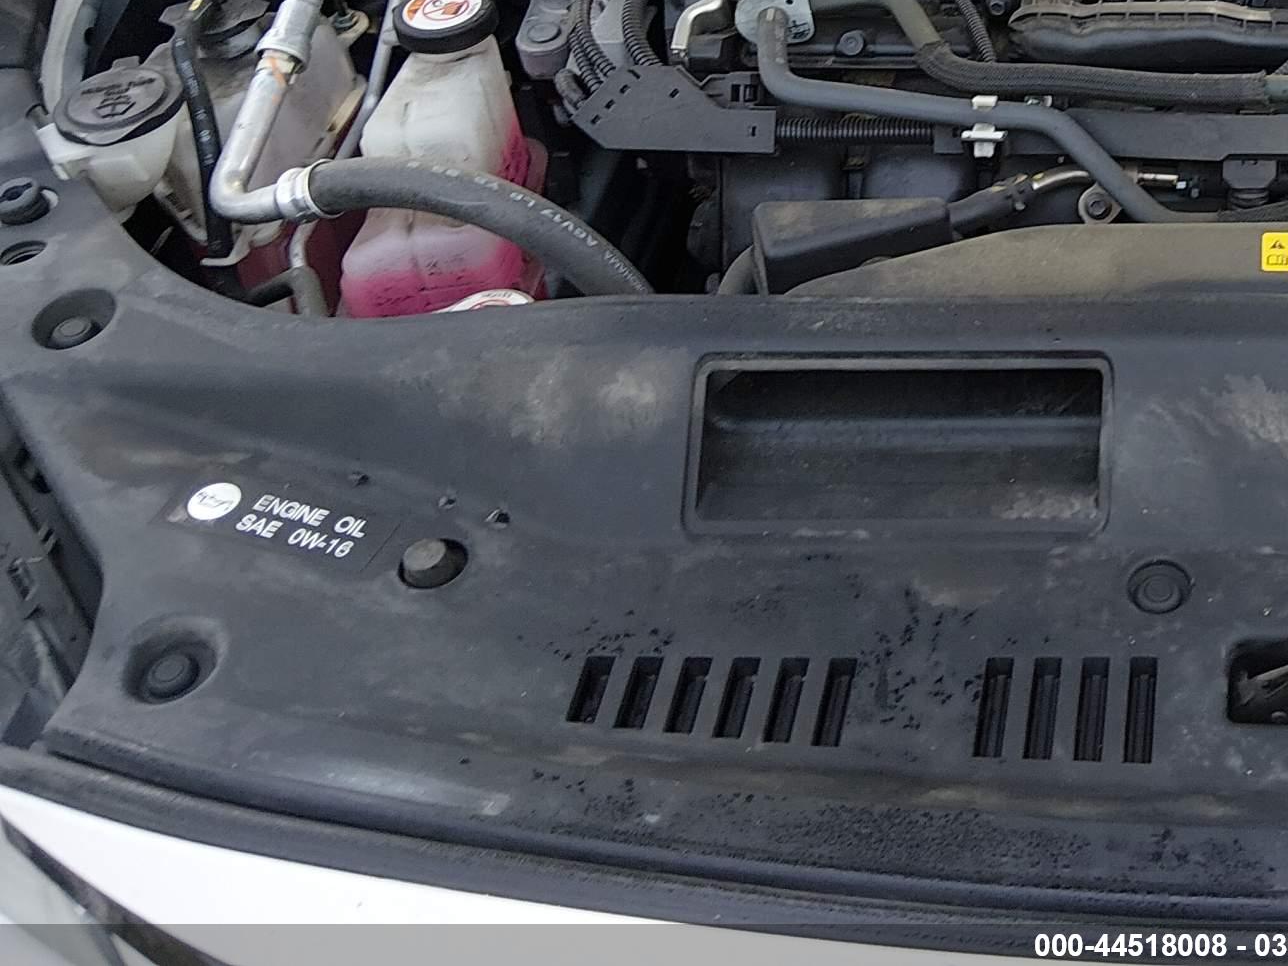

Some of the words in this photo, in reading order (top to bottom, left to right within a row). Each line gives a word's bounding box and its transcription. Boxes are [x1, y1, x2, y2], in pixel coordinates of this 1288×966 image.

[235, 514, 283, 539] SAE
[287, 528, 354, 558] 0W-16
[252, 494, 330, 527] ENGINE
[334, 516, 367, 538] OIL
